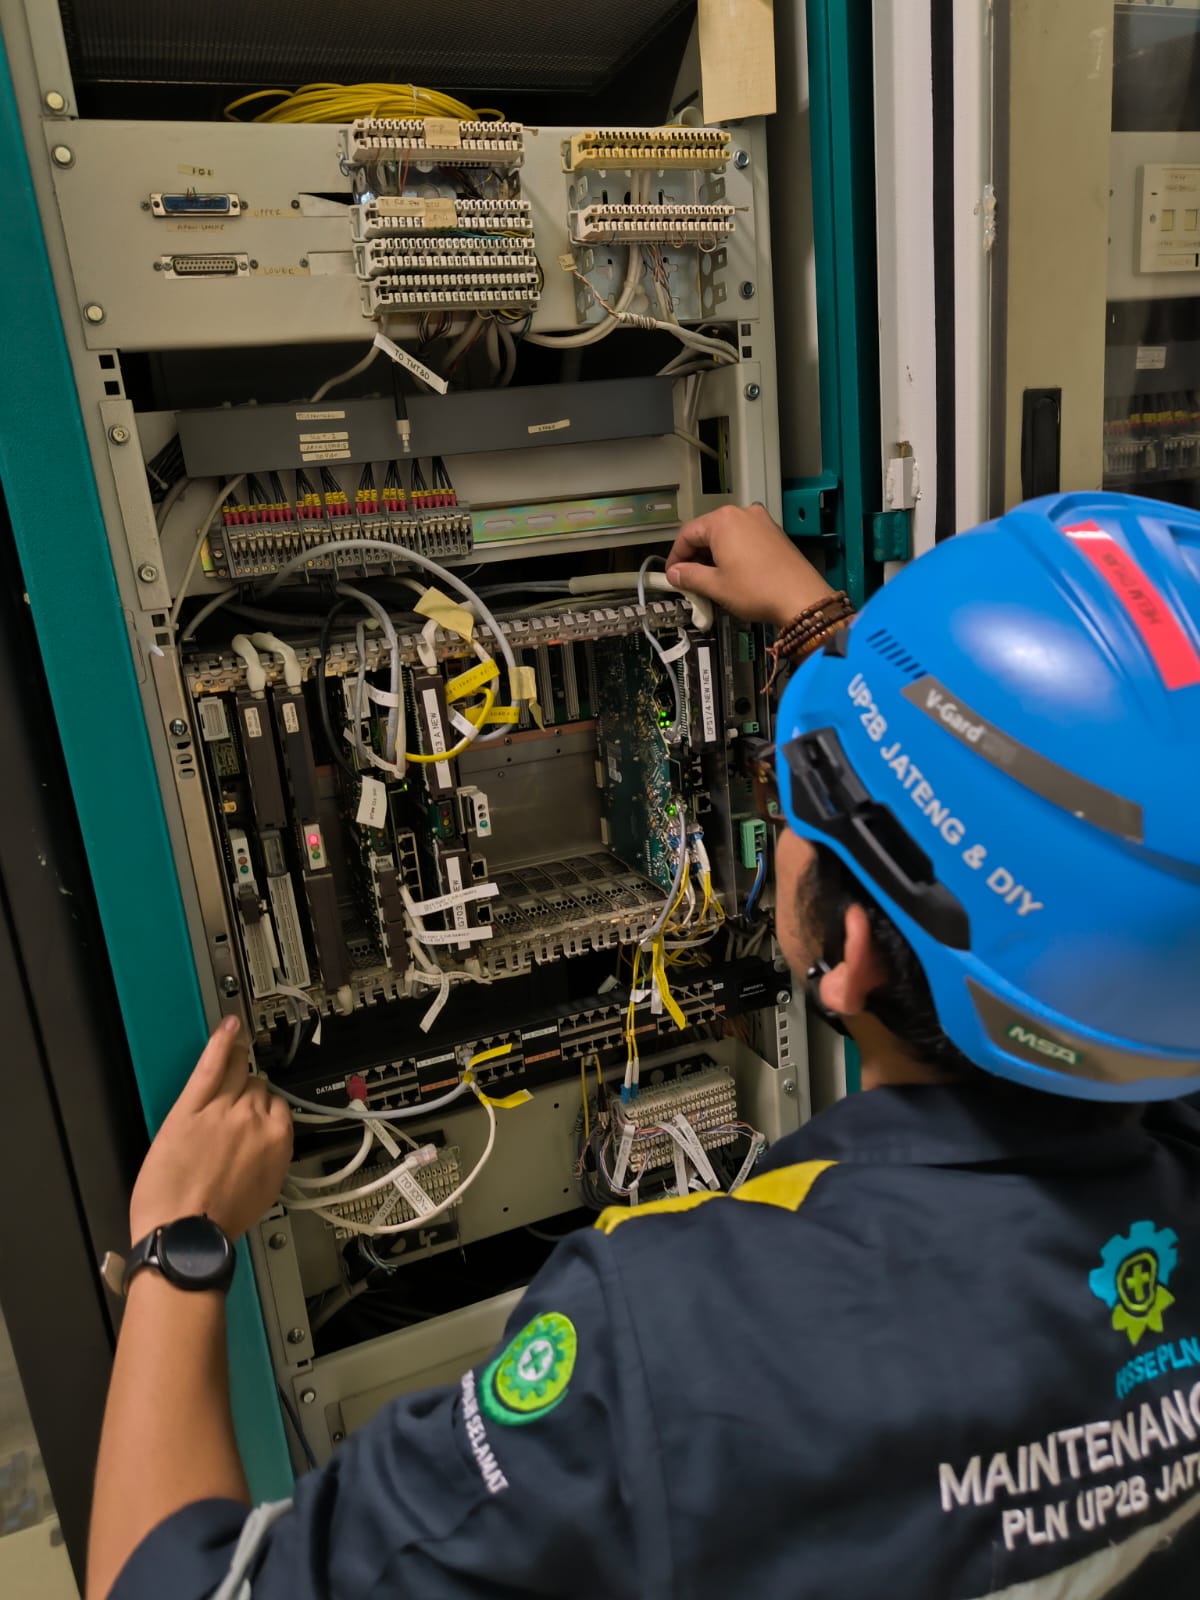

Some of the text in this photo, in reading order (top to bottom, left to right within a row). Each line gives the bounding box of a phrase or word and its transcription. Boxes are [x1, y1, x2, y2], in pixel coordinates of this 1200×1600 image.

[394, 348, 404, 361] TO
[430, 712, 439, 731] NEW
[924, 687, 985, 743] V-Gard
[846, 673, 1044, 917] UP2B JATENG & DIY
[1008, 1025, 1076, 1065] MSA
[315, 1085, 333, 1096] DATA
[399, 1177, 412, 1191] TO
[1002, 1452, 1200, 1552] PLN UP2B JAT
